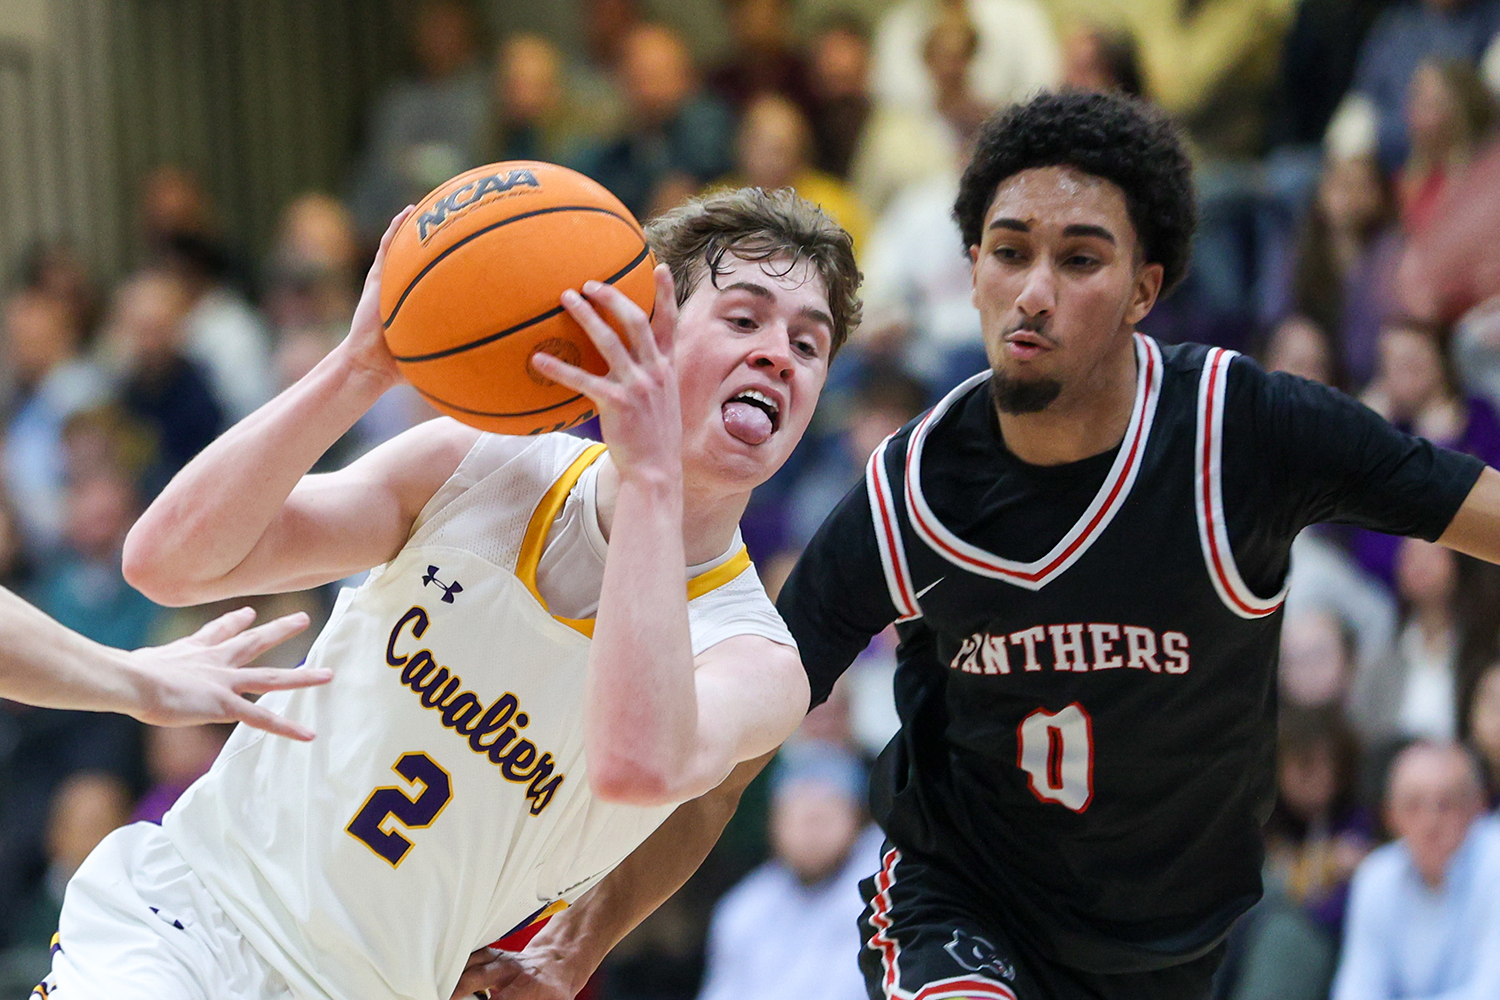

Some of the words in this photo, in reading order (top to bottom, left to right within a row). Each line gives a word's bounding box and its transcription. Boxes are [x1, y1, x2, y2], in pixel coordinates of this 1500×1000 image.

[416, 168, 541, 243] NCAA
[386, 605, 564, 817] Cavaliers
[1017, 701, 1094, 814] 0
[344, 750, 454, 870] 2
